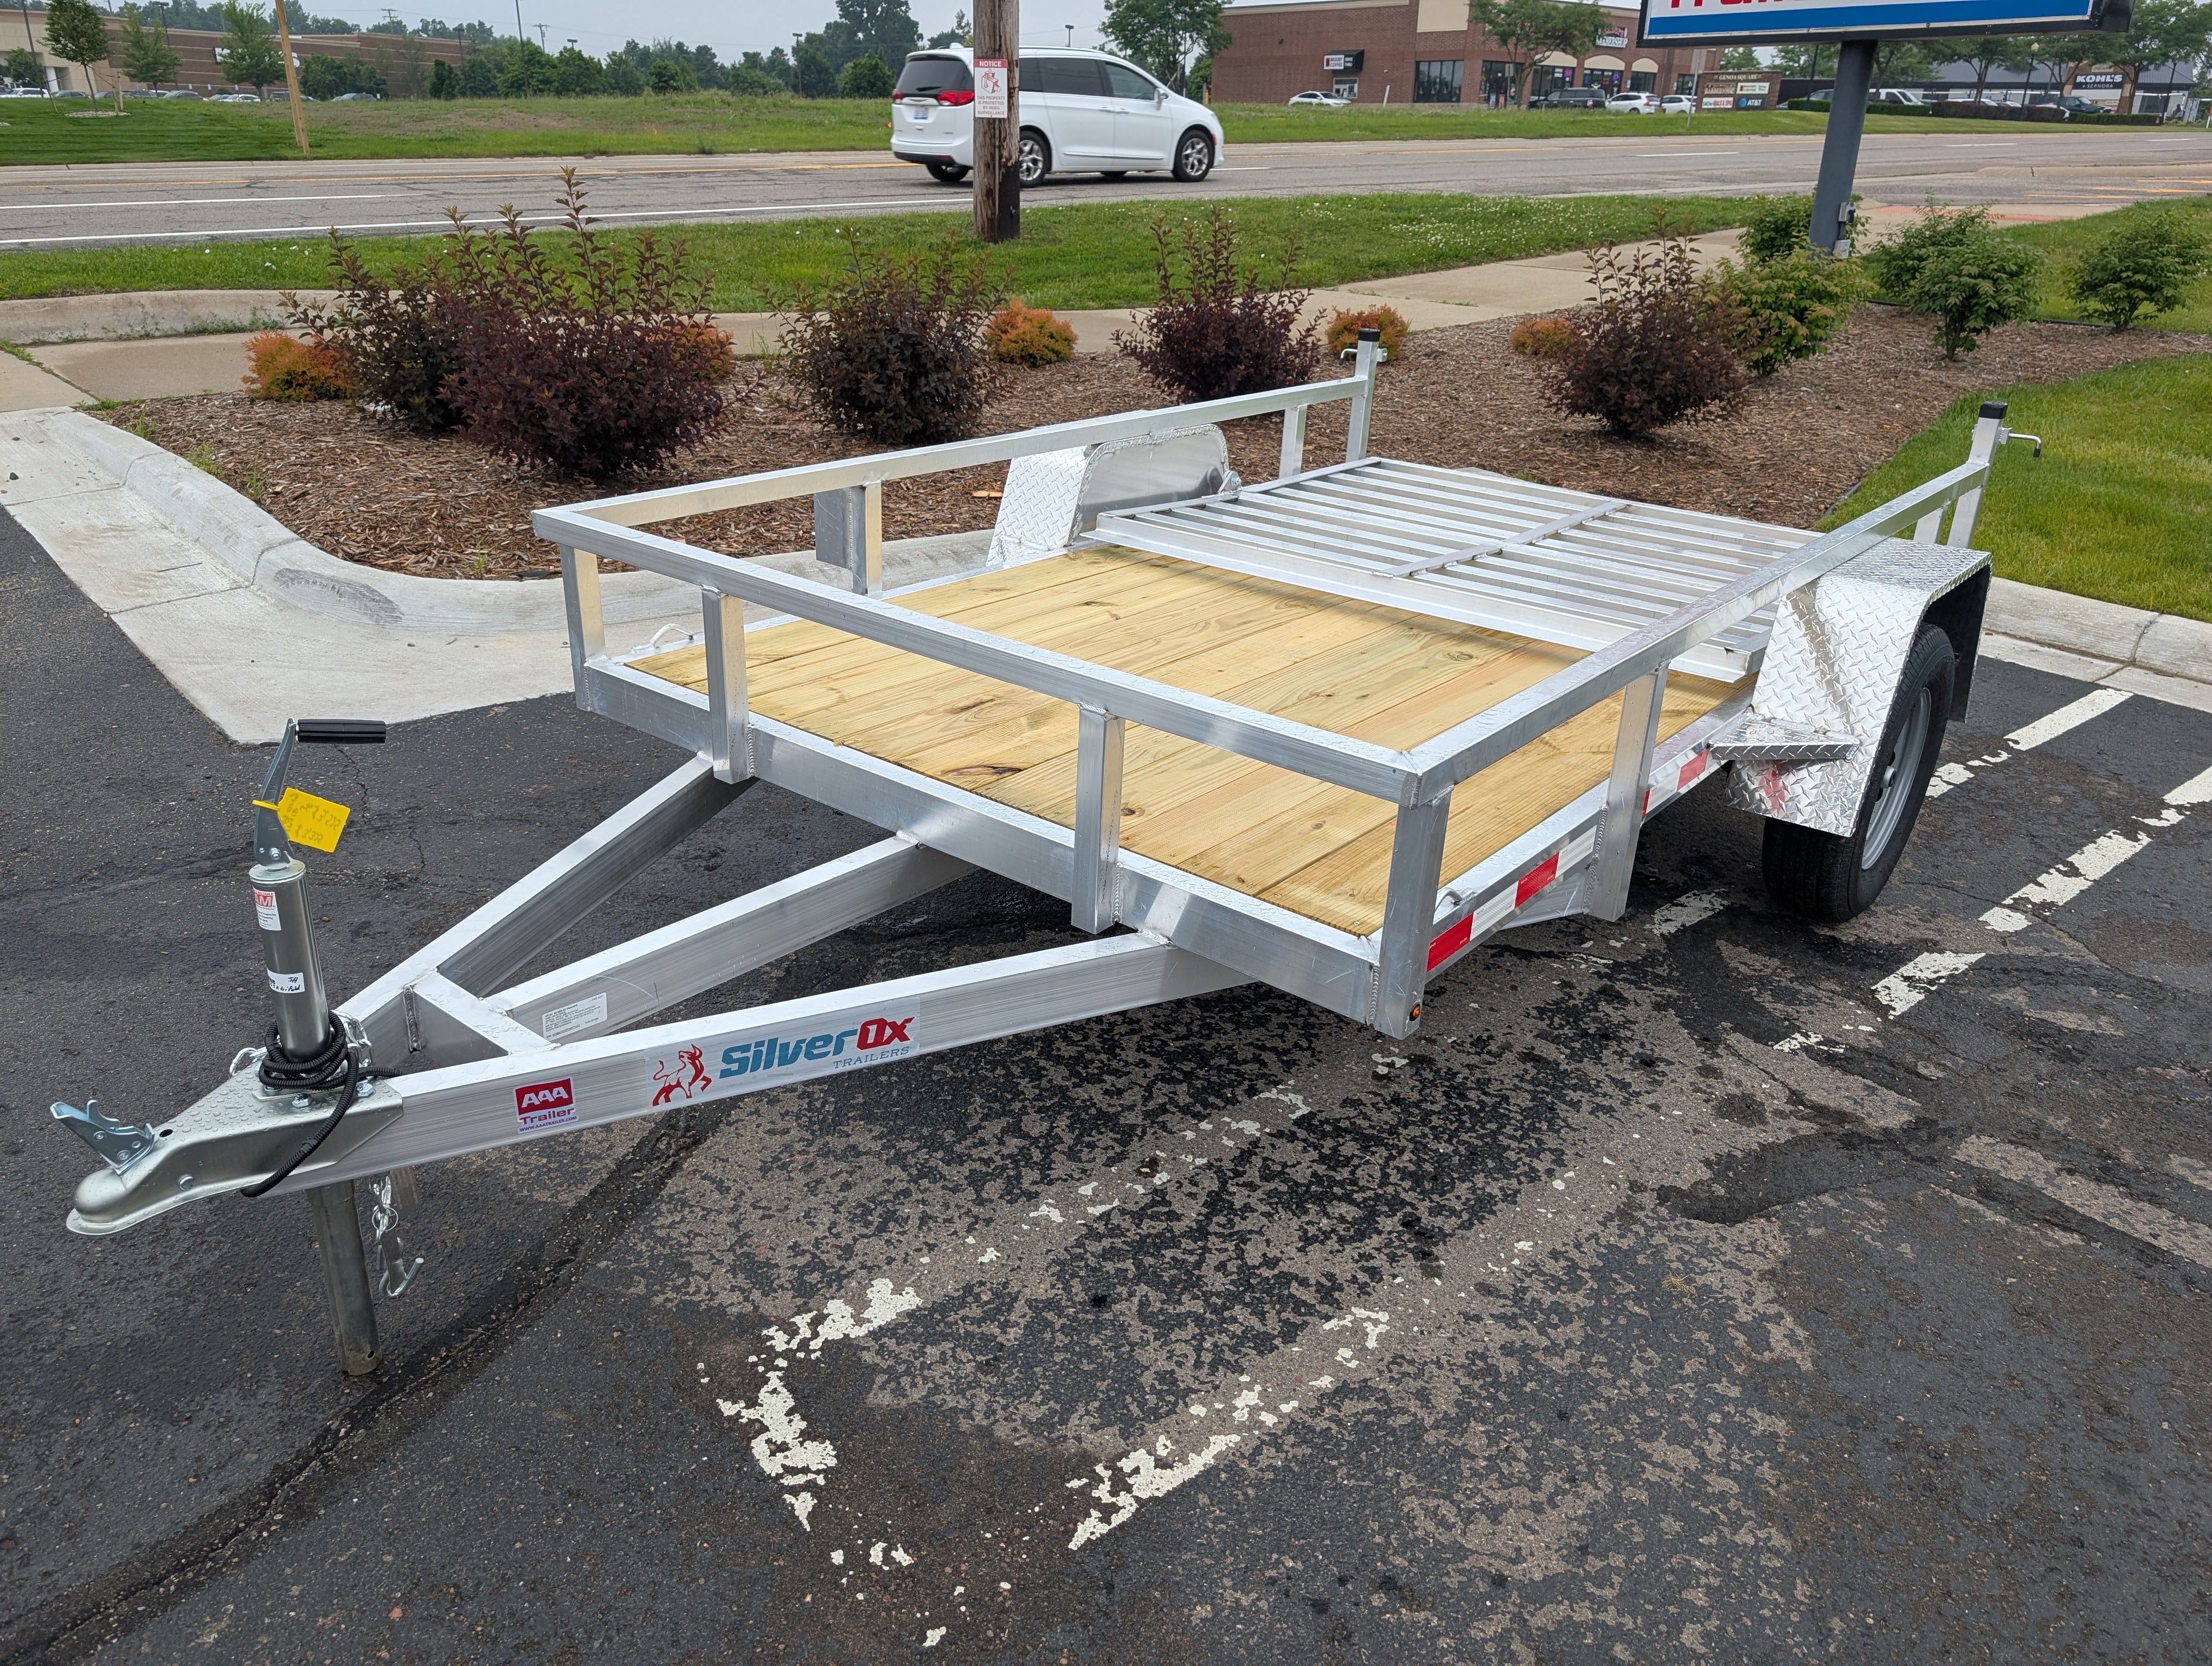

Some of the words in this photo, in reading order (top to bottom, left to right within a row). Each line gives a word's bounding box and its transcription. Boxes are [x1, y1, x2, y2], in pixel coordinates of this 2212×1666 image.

[2076, 74, 2123, 82] KOHL'S
[833, 1046, 909, 1069] TRAILERS
[521, 1086, 569, 1108] AAA
[519, 1108, 575, 1125] Trailer
[519, 1116, 577, 1132] WWW.AAATRAILER.COM
